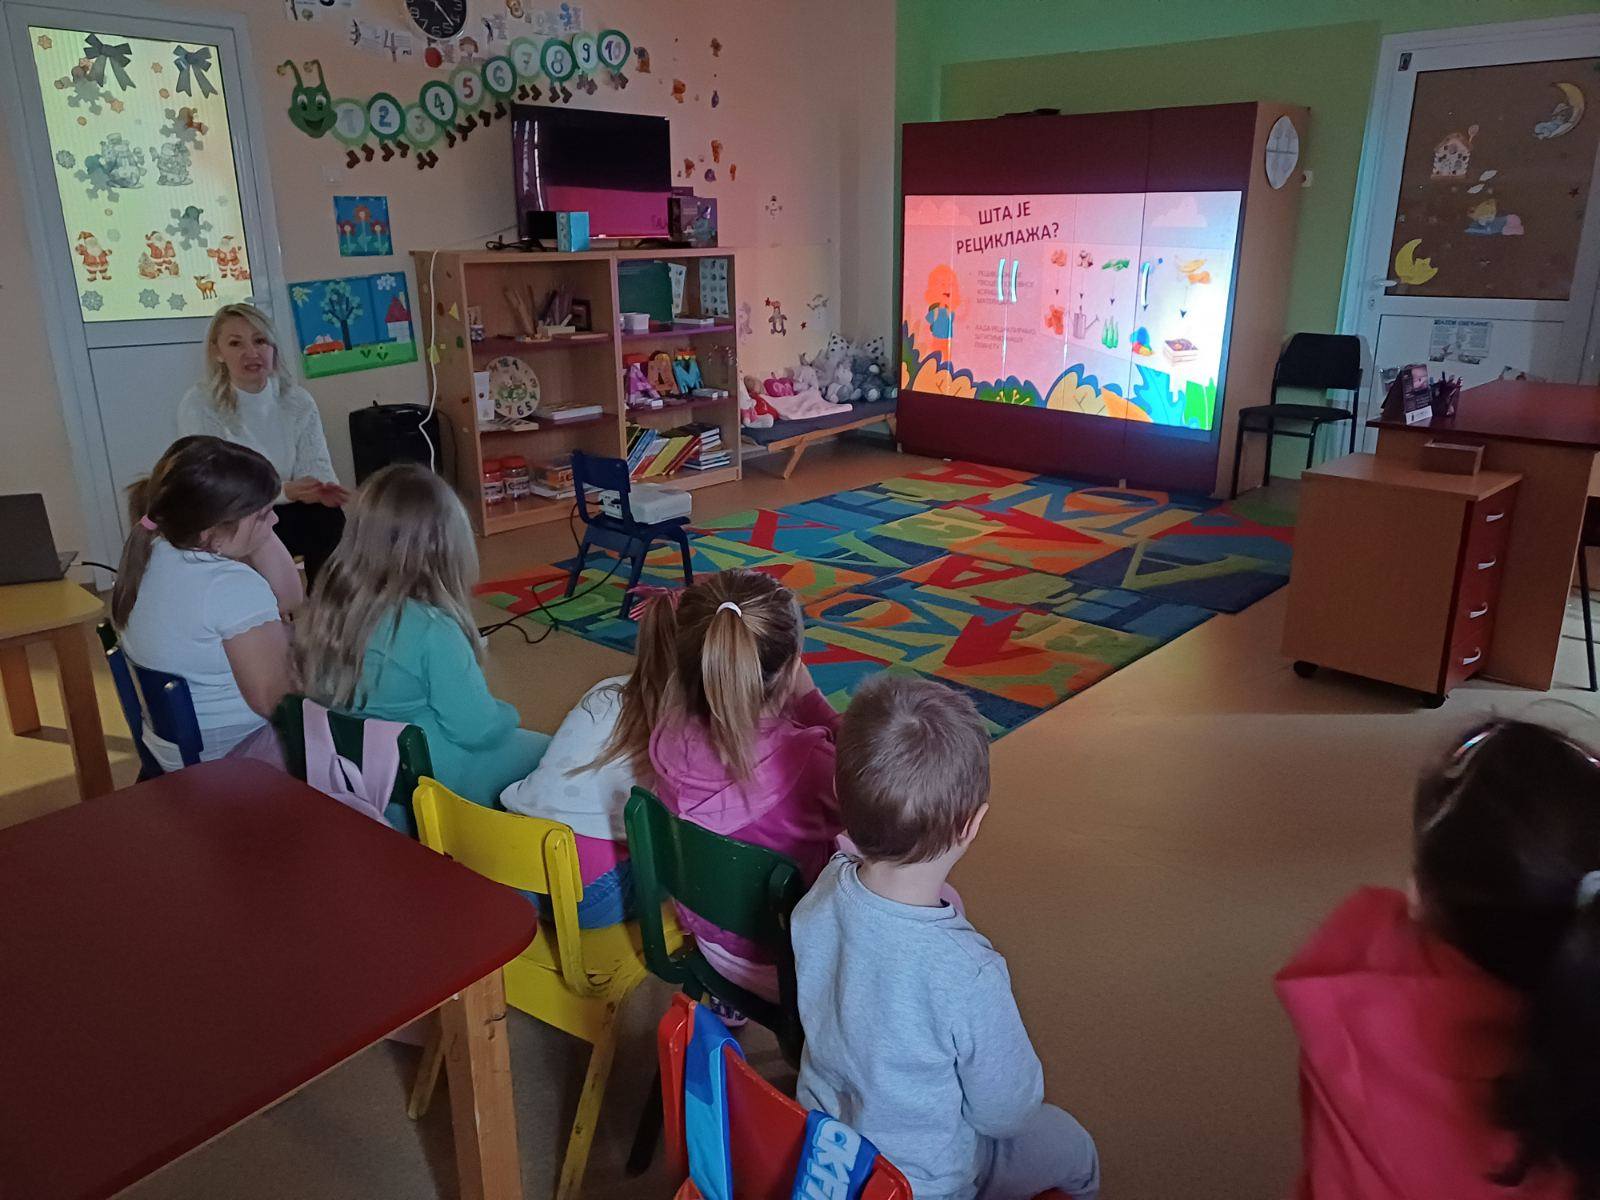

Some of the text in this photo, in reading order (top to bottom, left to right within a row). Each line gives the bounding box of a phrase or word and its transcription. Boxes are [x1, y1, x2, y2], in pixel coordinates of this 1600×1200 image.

[462, 77, 474, 99] 5
[492, 66, 506, 87] 6
[433, 92, 446, 116] 4
[378, 105, 392, 128] 2
[978, 201, 1032, 225] ШТА ЈЕ
[956, 221, 1060, 254] РЕЦИКЛАЖА?
